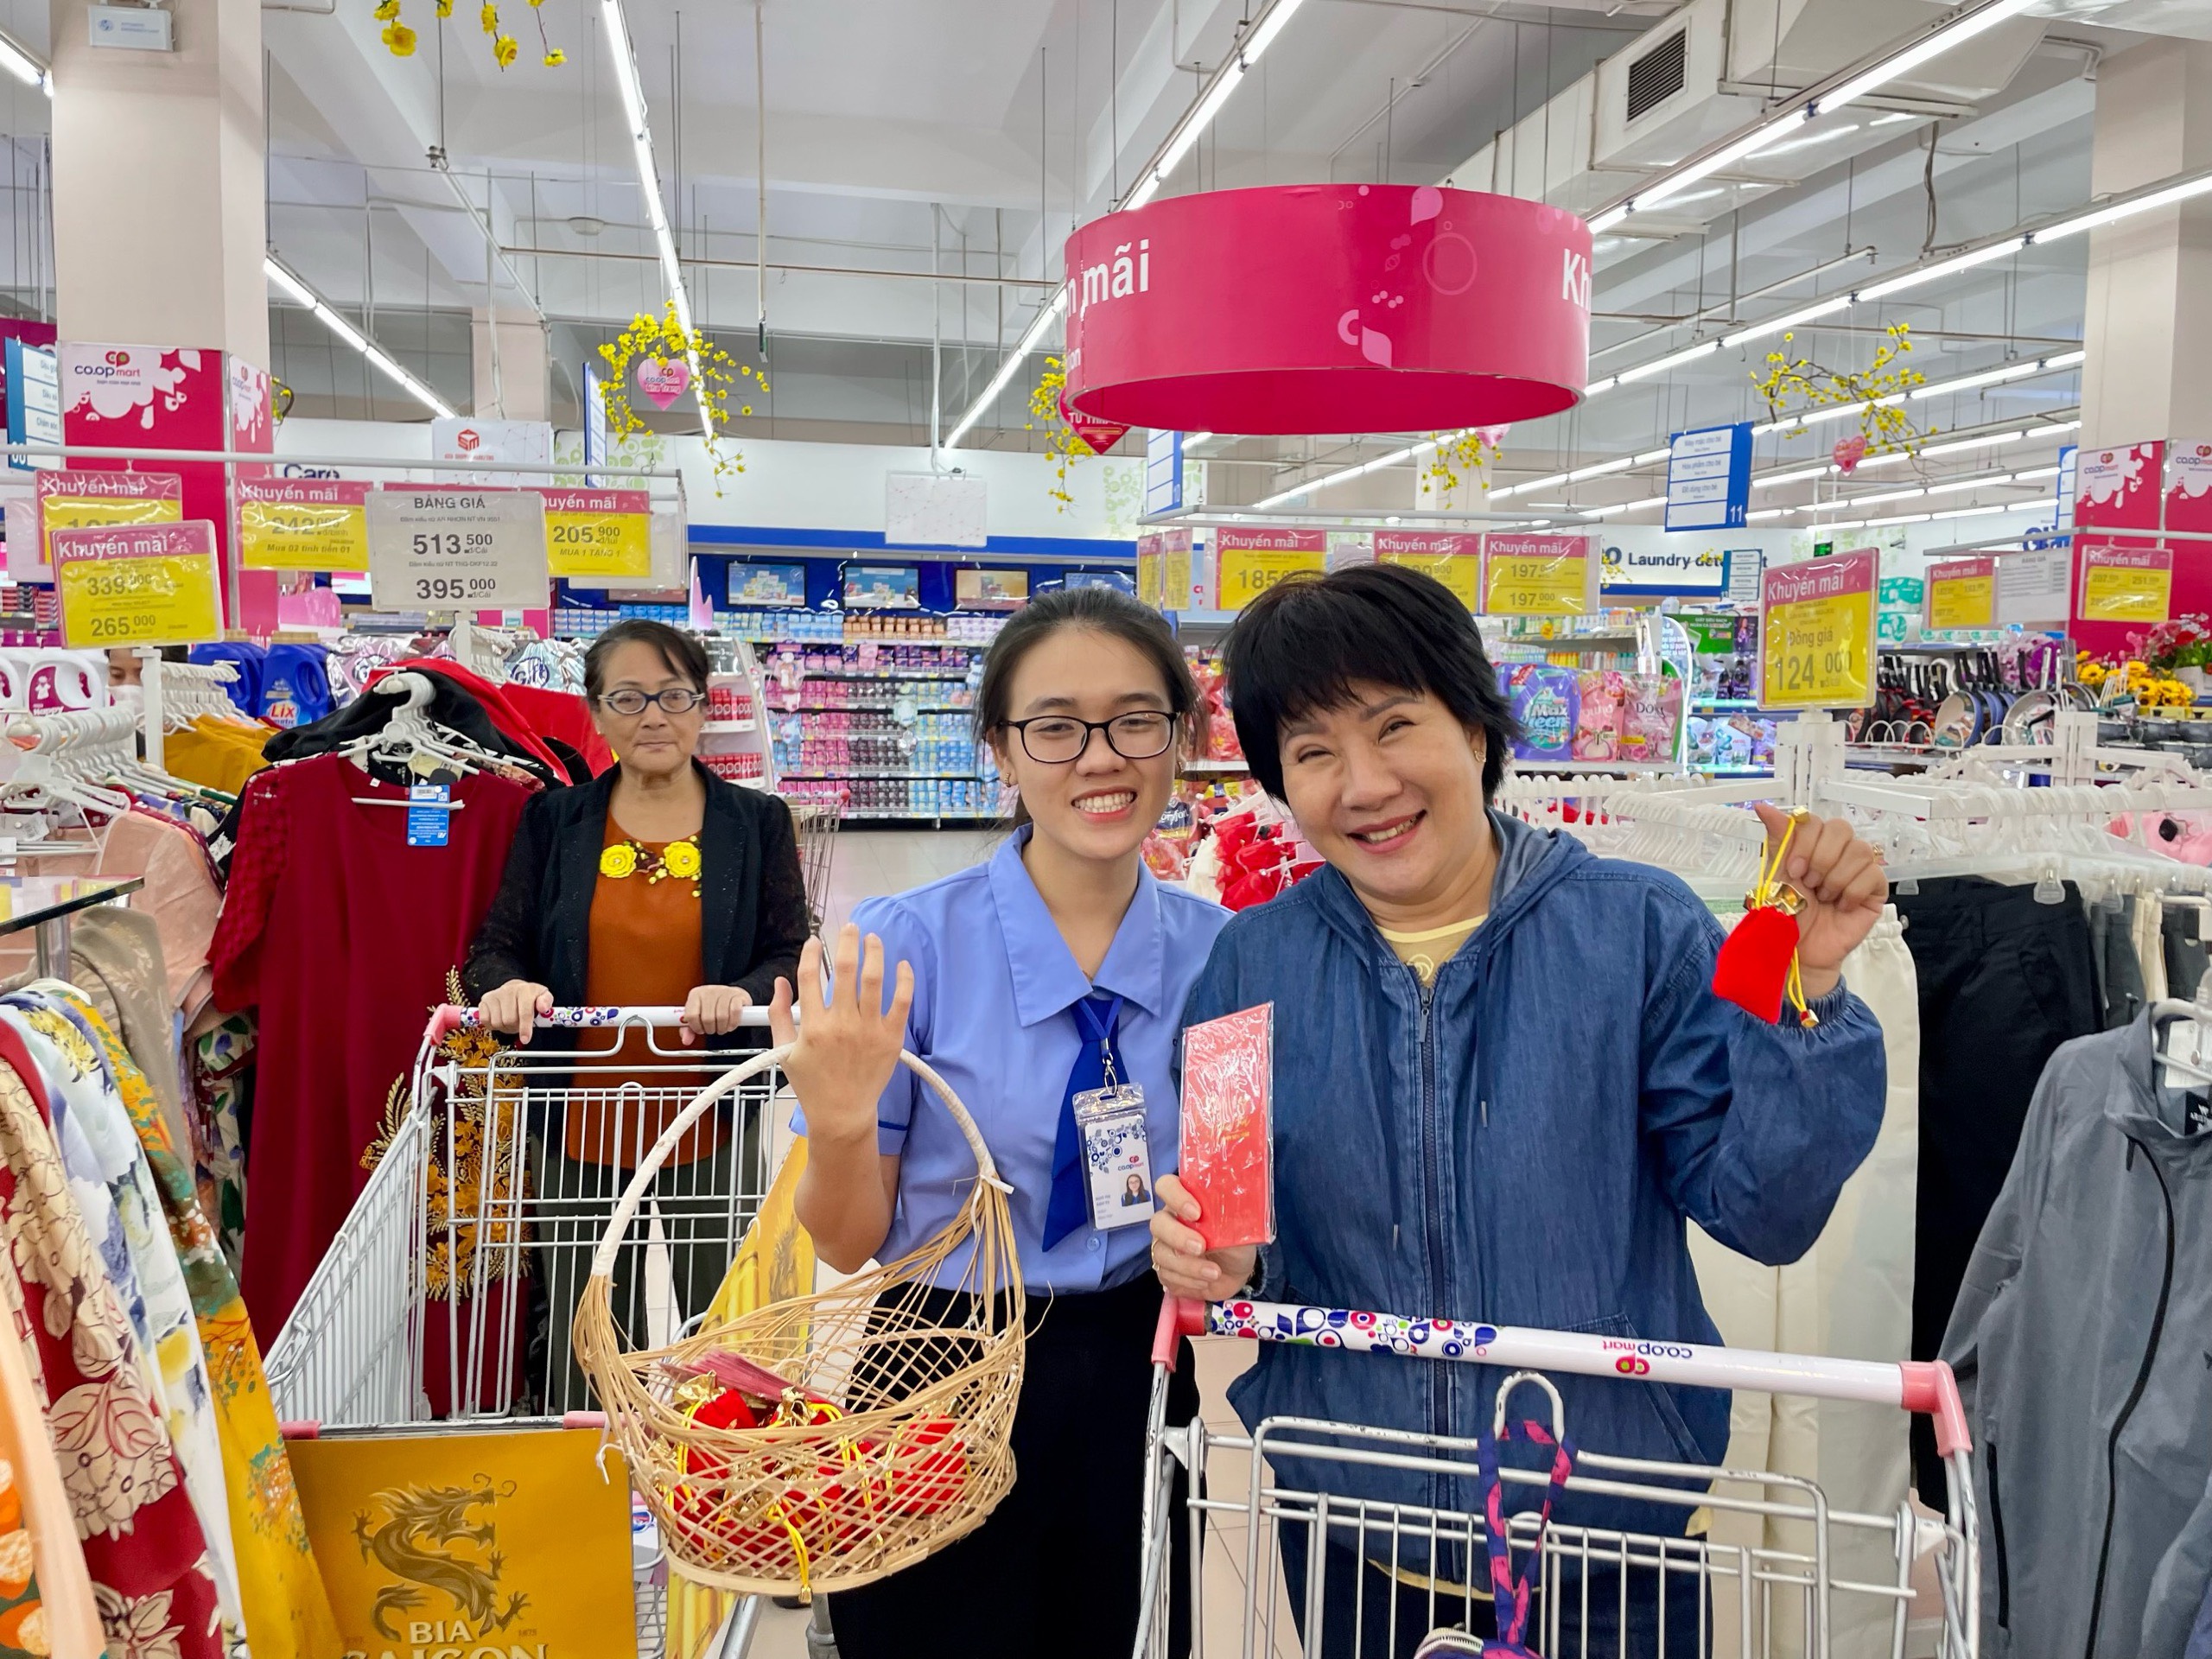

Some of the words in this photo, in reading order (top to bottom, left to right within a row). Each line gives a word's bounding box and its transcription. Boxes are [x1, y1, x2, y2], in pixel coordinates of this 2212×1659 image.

[1082, 238, 1150, 311] mãi
[240, 483, 304, 502] Khuyến
[308, 484, 339, 501] mãi
[414, 494, 456, 509] BẢNG
[460, 494, 486, 509] GIÁ
[588, 494, 618, 510] mãi
[1730, 505, 1744, 523] 11
[58, 534, 129, 561] Khuyến
[133, 532, 168, 555] mãi
[1222, 533, 1272, 550] Khuyến
[1274, 534, 1300, 548] mãi
[1378, 537, 1427, 554] Khuyến
[1490, 539, 1537, 556] Khuyến
[1539, 540, 1563, 554] mãi
[1628, 552, 1691, 570] Laundry
[1768, 570, 1815, 602] Khuyến
[1819, 568, 1845, 594] mãi
[270, 703, 296, 720] Lix
[409, 1619, 477, 1645] BIA
